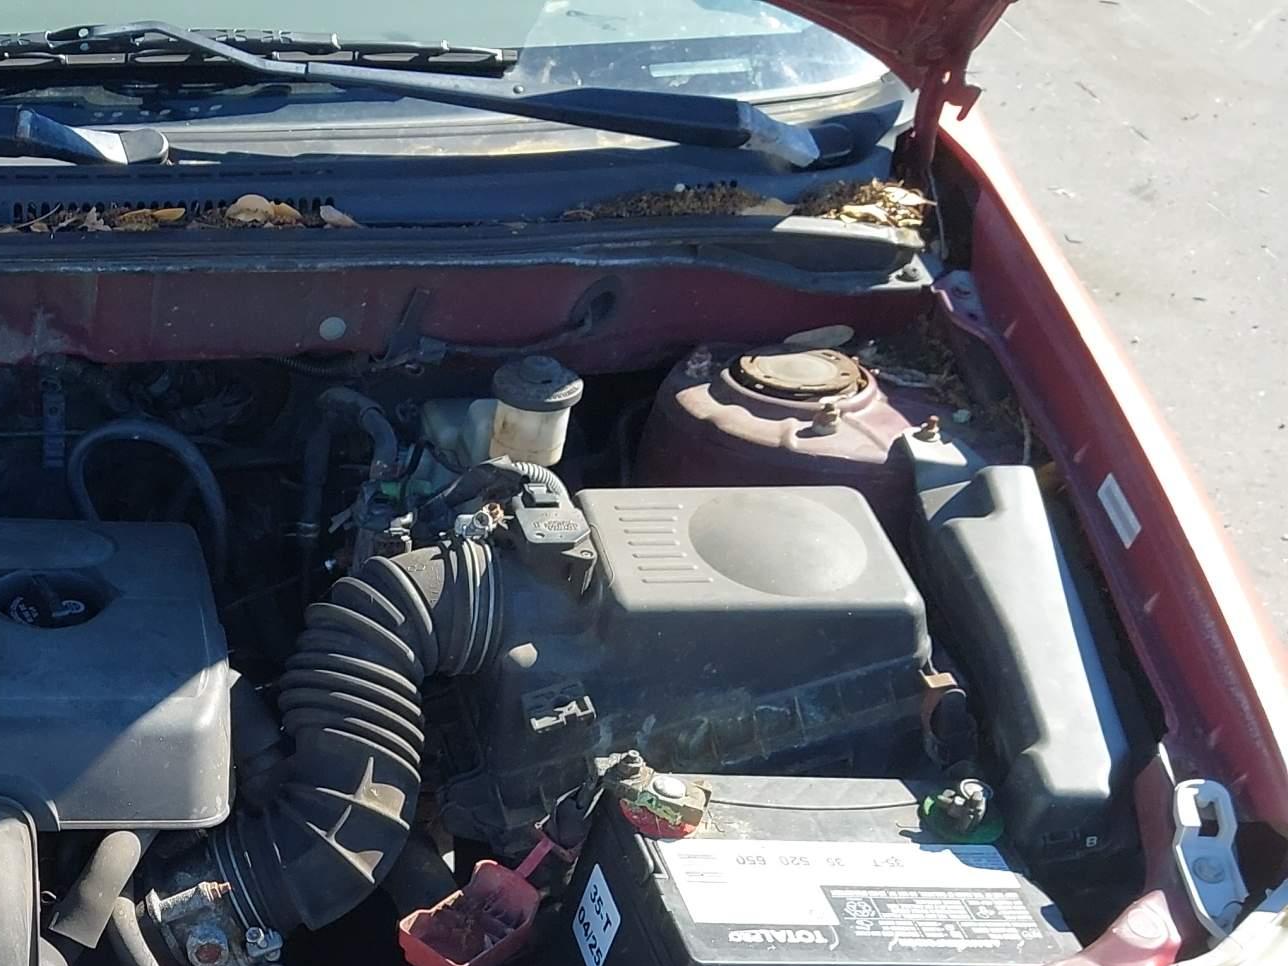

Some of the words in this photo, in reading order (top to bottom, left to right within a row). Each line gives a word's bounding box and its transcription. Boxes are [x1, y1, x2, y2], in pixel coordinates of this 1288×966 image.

[735, 855, 768, 866] 650
[778, 855, 812, 867] 520
[589, 884, 612, 935] 35-T
[577, 905, 604, 966] 04/25
